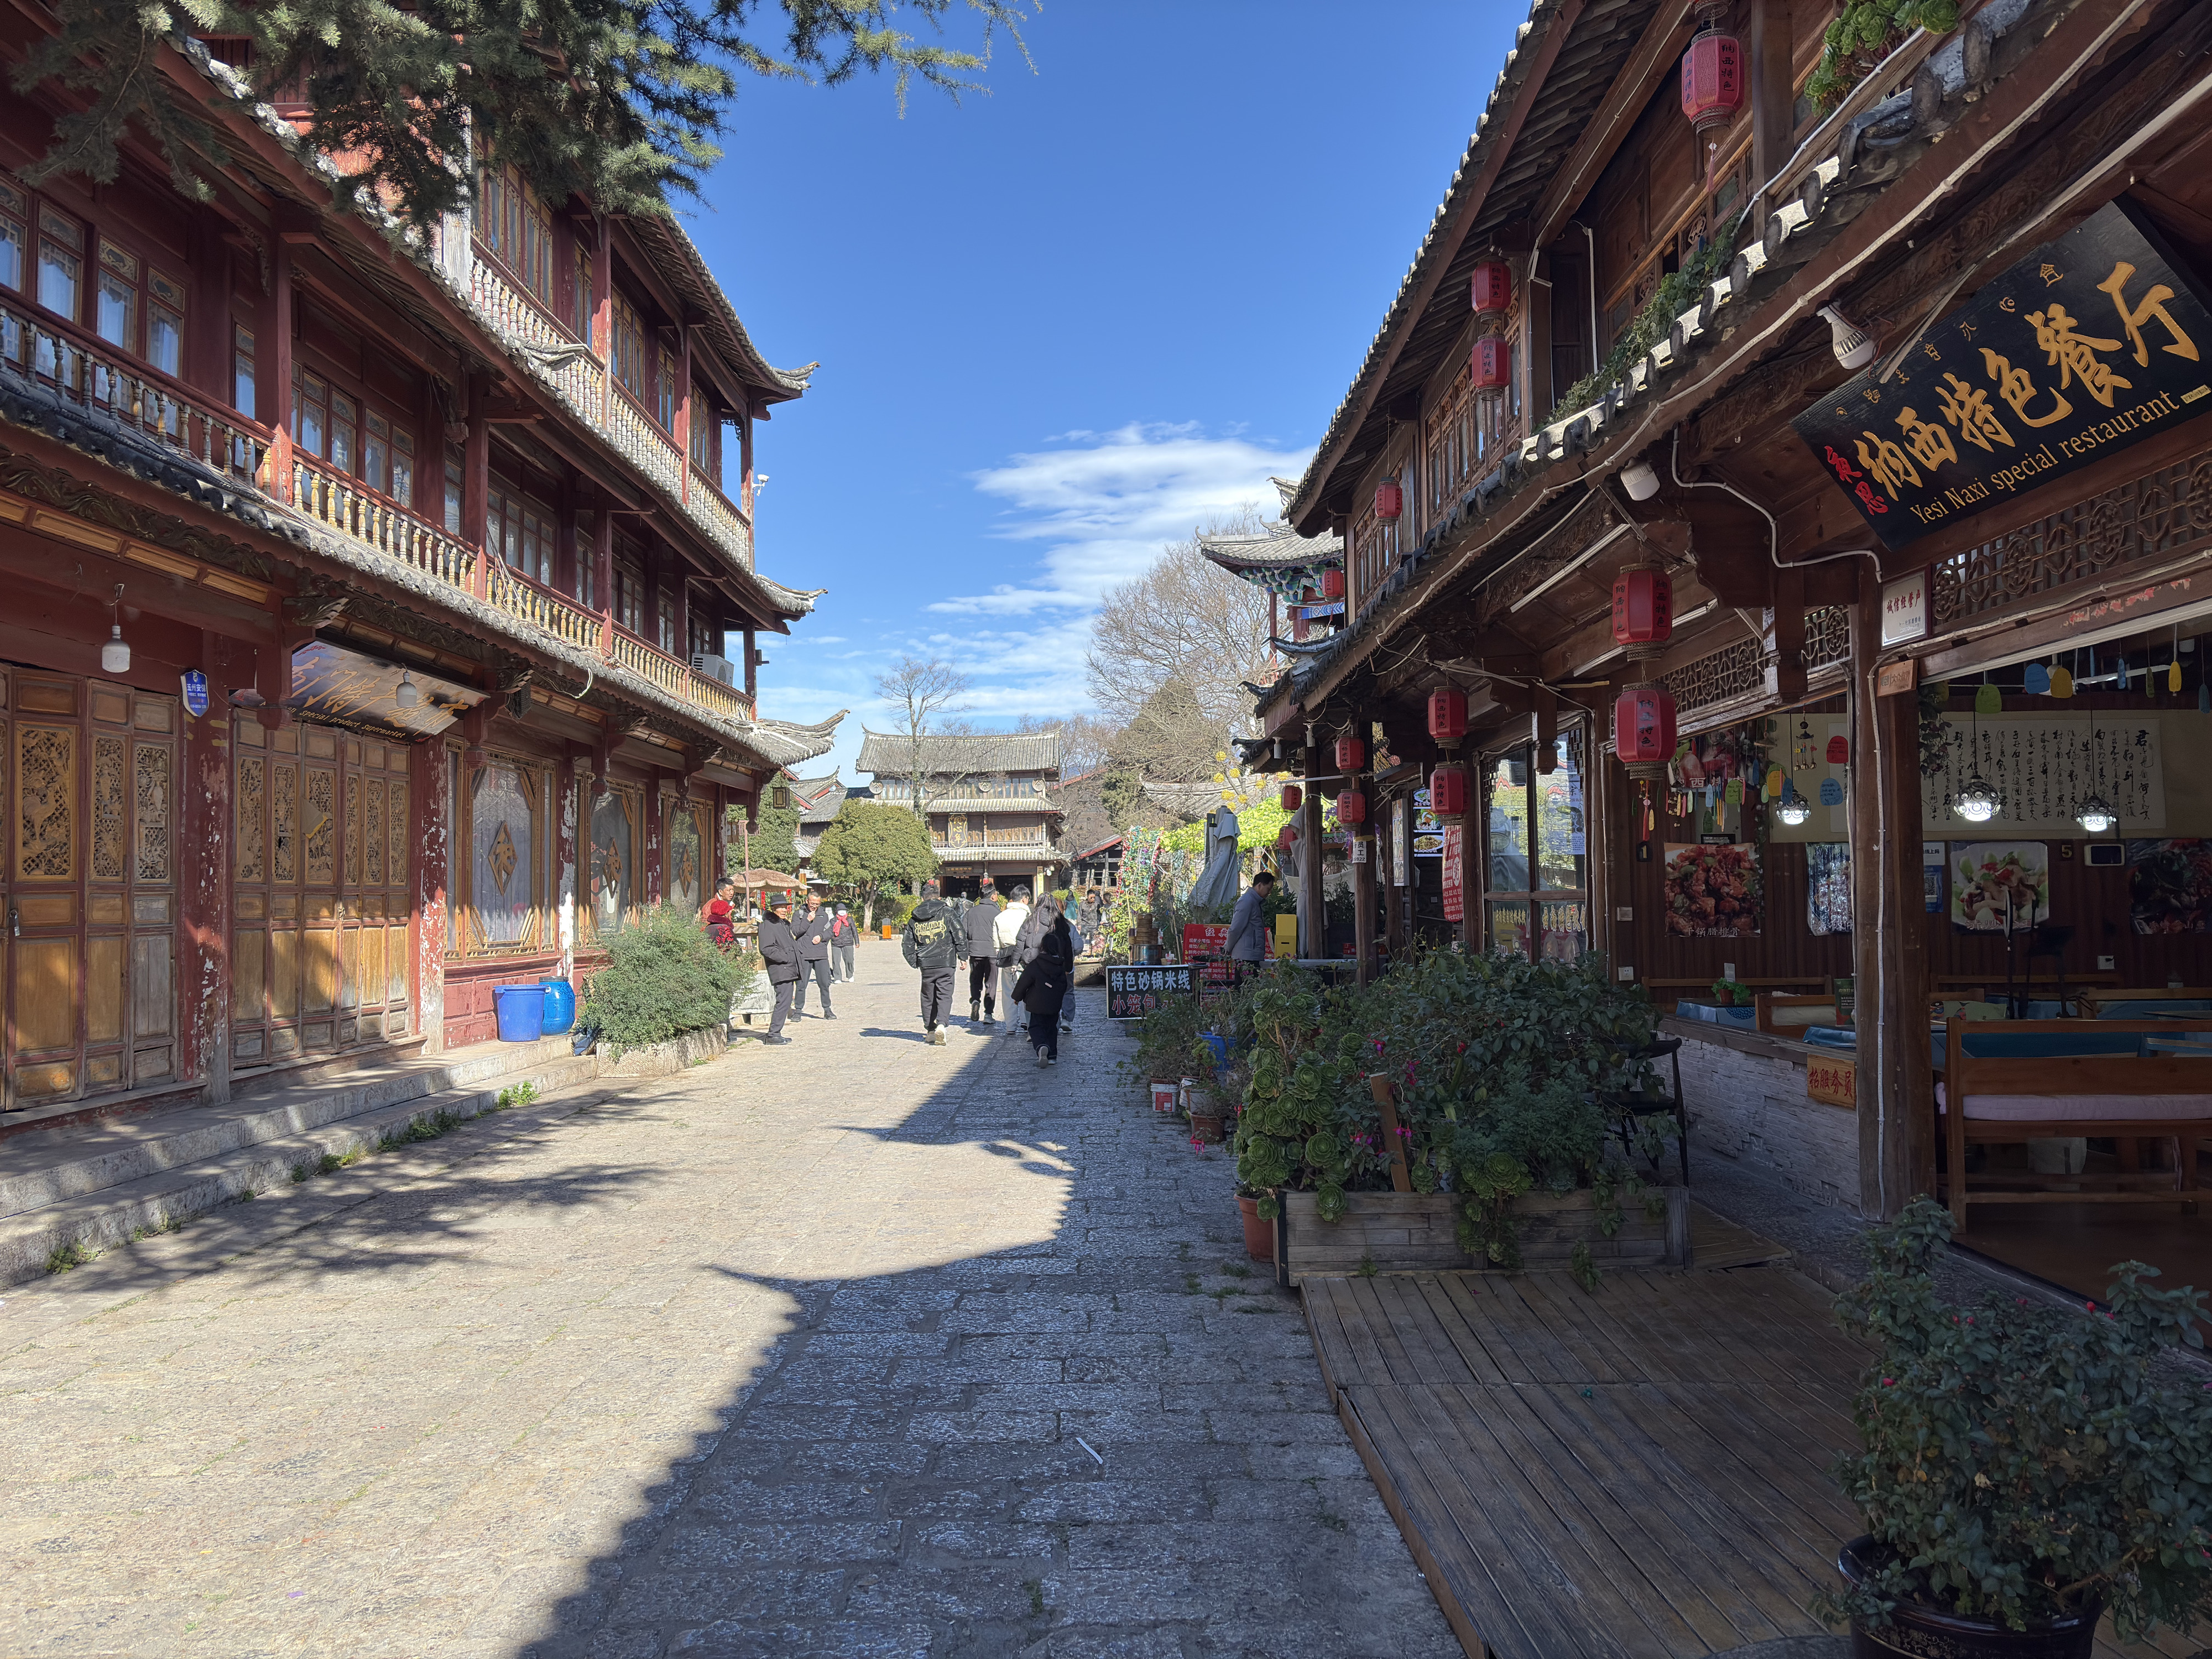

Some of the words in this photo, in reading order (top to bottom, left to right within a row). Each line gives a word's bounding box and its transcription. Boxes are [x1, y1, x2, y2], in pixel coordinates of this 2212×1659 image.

[1721, 44, 1735, 91] 纳西特色
[1853, 261, 2200, 502] 纳西特色餐厅
[1910, 497, 1949, 524] Yesi
[1954, 478, 1990, 511] Naxi
[1991, 447, 2058, 492] special
[2059, 389, 2180, 458] restaurant
[1887, 589, 1921, 614] 诚信经营户
[299, 709, 328, 720] special
[329, 717, 361, 728] product
[361, 723, 406, 739] supermarket
[1437, 698, 1447, 729] 纳西特色
[1436, 775, 1445, 807] 纳西特色
[1358, 842, 1364, 855] 员工
[1641, 845, 1648, 859] 1
[2061, 845, 2072, 858] 5
[1111, 970, 1191, 992] 特色砂锅米线
[1112, 994, 1156, 1015] 小笼包
